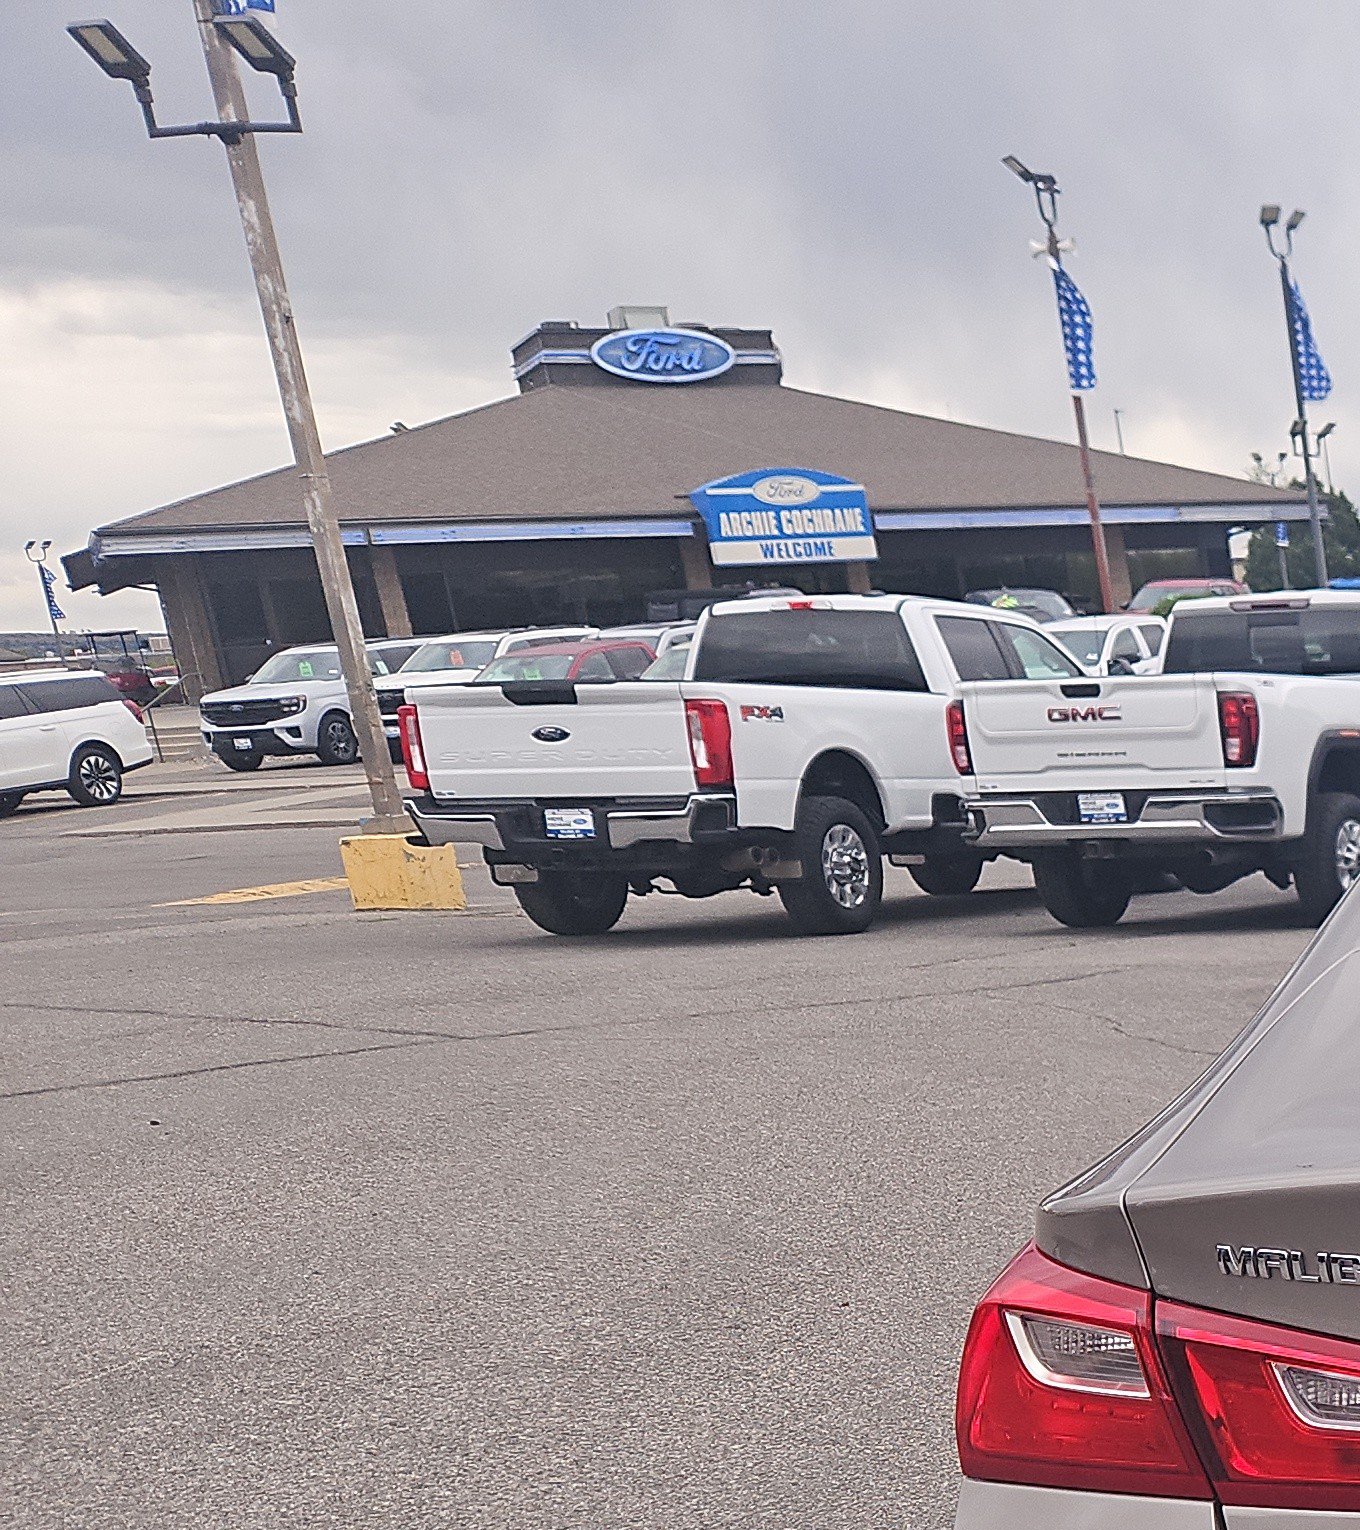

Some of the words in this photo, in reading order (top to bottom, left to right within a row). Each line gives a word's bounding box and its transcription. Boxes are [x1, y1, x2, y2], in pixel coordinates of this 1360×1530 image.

[621, 334, 703, 371] Ford
[766, 481, 805, 498] Ford
[719, 510, 780, 537] ARCHIE
[779, 507, 867, 535] COCHRANE
[759, 540, 835, 559] WELCOME
[1047, 706, 1122, 722] GMC
